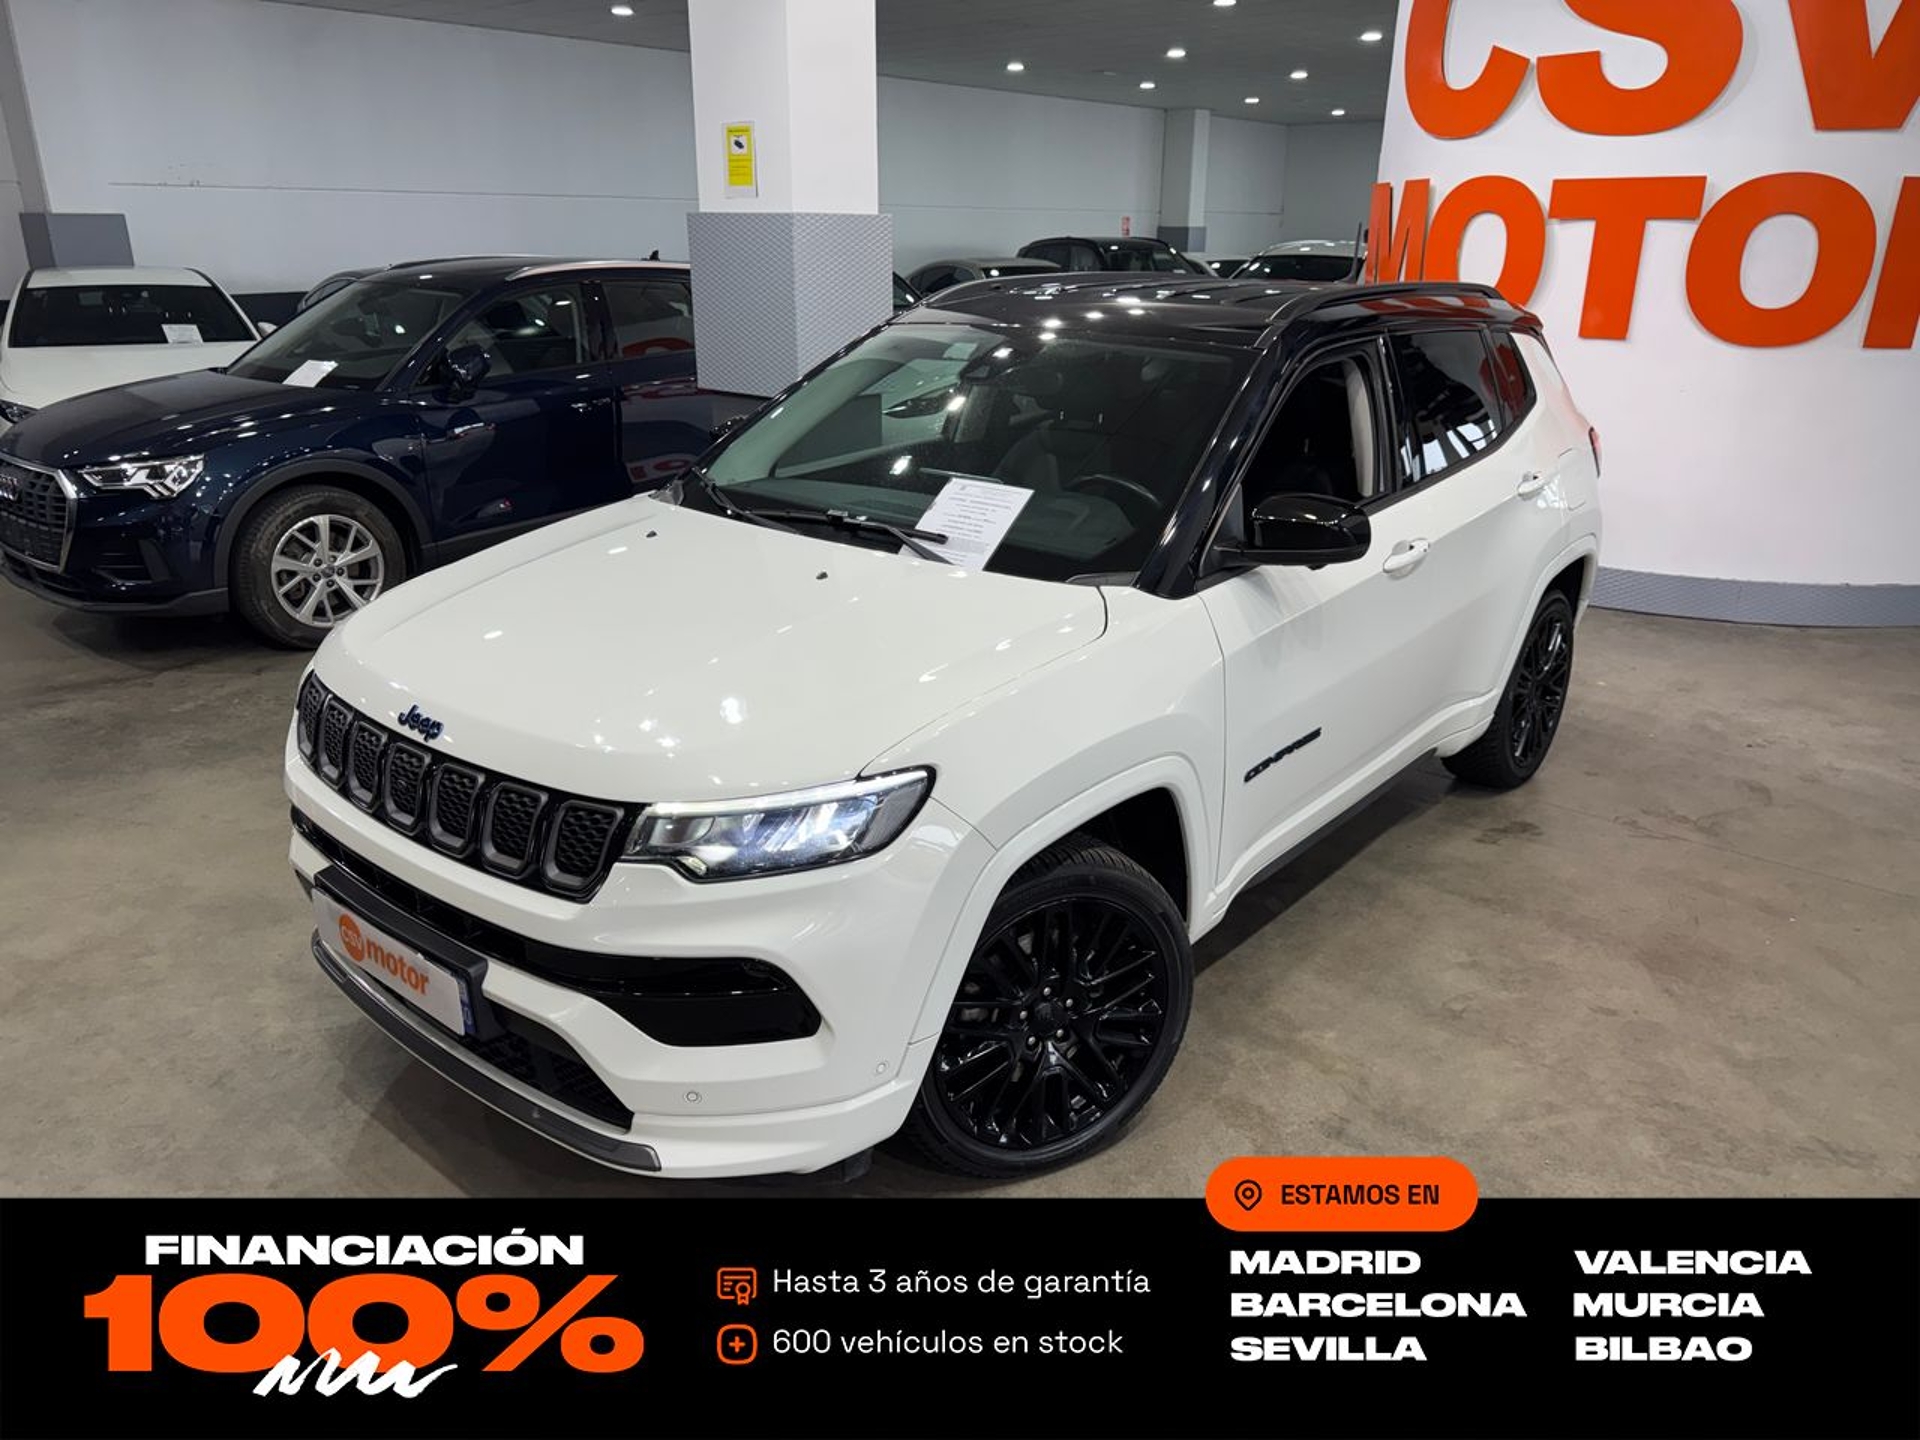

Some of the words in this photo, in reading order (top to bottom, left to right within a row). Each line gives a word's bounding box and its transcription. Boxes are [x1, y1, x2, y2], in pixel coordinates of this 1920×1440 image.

[1365, 171, 1920, 348] MOTO
[398, 704, 444, 743] Jeep
[366, 936, 430, 995] motor
